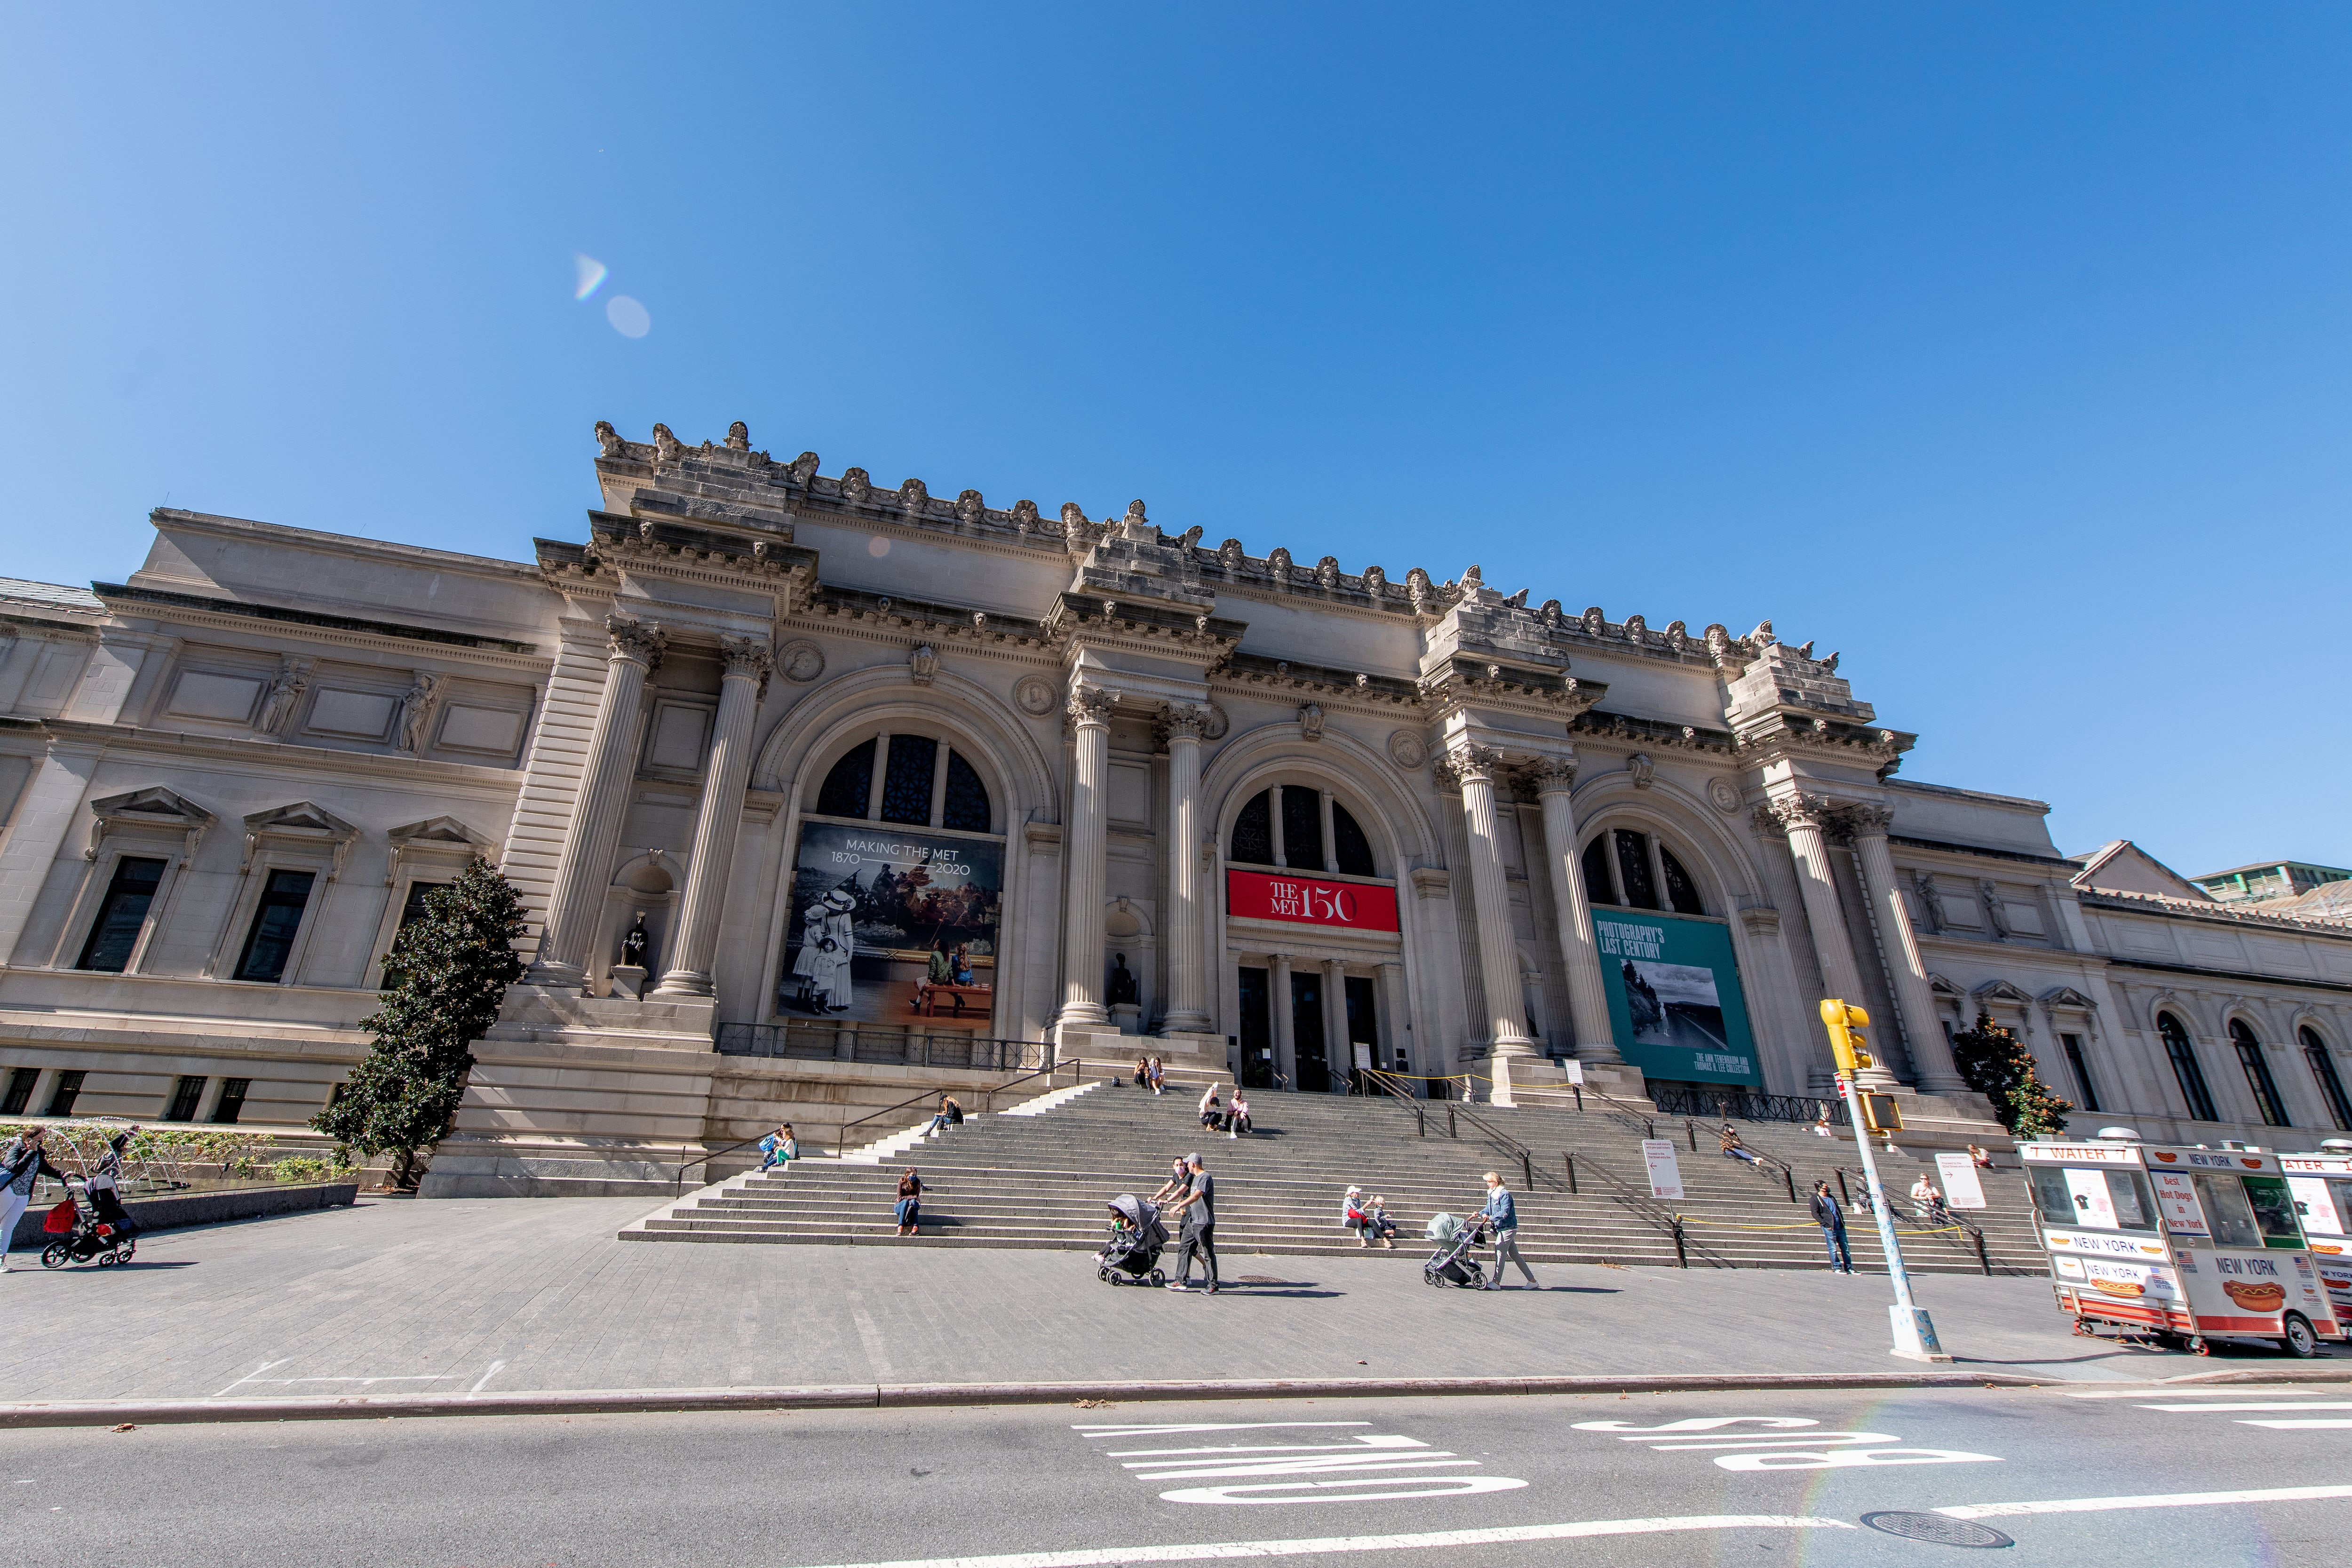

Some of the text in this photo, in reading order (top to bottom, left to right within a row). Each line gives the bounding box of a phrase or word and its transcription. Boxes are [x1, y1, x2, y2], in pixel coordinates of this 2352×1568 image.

[846, 839, 959, 861] MAKING THE MET
[831, 852, 970, 876] 1870 2020
[1270, 882, 1298, 899] THE
[1270, 898, 1299, 915] MET
[1300, 885, 1357, 921] 150
[1597, 920, 1664, 943] PHOTOGRAPHY'S
[1600, 937, 1660, 959] LAST CENTURY
[1695, 1052, 1748, 1066] THE ANN TENENBAUM AND
[1694, 1061, 1712, 1071] THOMAS
[1712, 1063, 1718, 1072] H.
[1726, 1064, 1750, 1074] COLLECTION
[2050, 1148, 2106, 1160] WATER
[2189, 1154, 2233, 1167] NEW YORK
[2285, 1161, 2325, 1170] ATER
[2163, 1176, 2180, 1186] Best
[2159, 1190, 2193, 1202] Hot Dogs
[2177, 1204, 2185, 1213] in
[2167, 1218, 2204, 1228] New York
[2074, 1237, 2138, 1253] NEW YORK
[2087, 1265, 2140, 1279] NEW YORK
[2216, 1258, 2242, 1274] NEW
[2244, 1259, 2279, 1276] YORK
